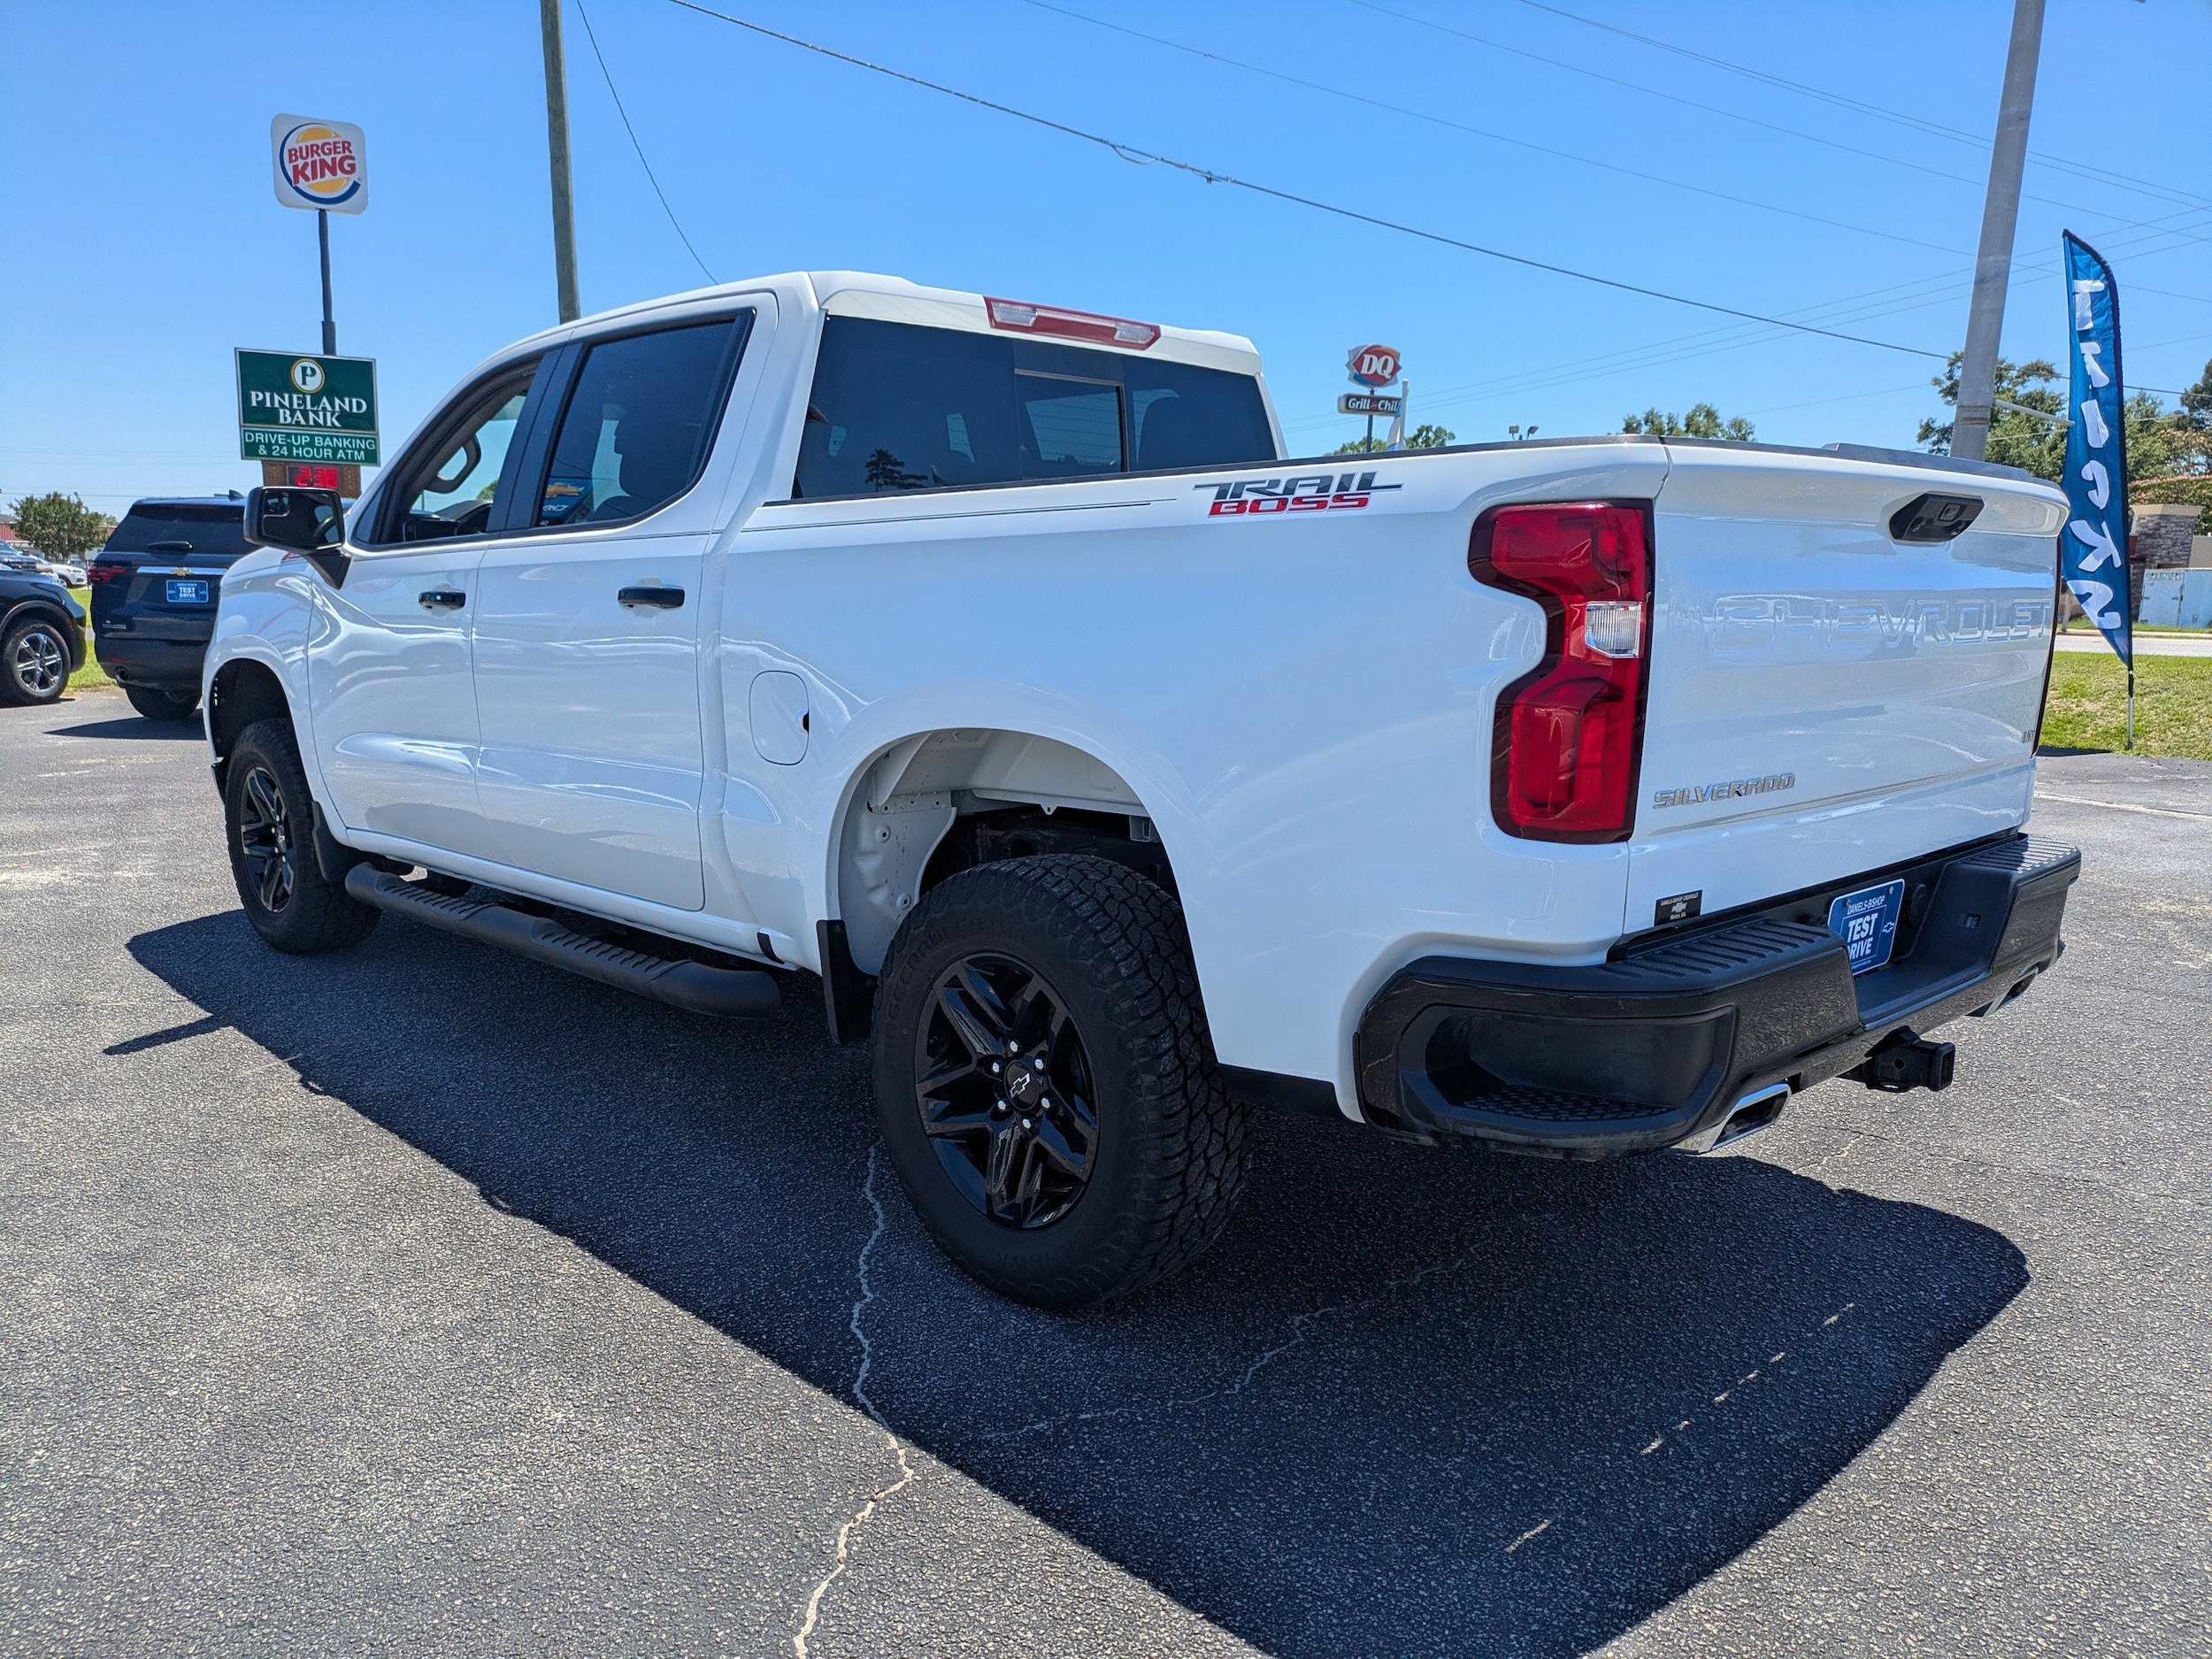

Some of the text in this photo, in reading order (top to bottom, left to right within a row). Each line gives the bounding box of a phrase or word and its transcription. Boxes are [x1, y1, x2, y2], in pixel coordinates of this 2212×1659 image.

[288, 140, 352, 165] BURGER
[291, 155, 357, 187] KING
[301, 365, 316, 386] P
[1360, 354, 1394, 379] DQ
[250, 390, 367, 414] PINELAND
[1348, 397, 1371, 411] Grill
[1378, 399, 1398, 412] Chil
[279, 408, 342, 427] BANK
[244, 432, 376, 450] DRIVE-UP BANKING
[257, 445, 365, 461] & 24 HOUR ATM
[1193, 470, 1405, 500] TRAIL
[1208, 492, 1371, 518] BOSS
[1653, 772, 1796, 810] SILVERADO
[1847, 895, 1886, 915] DANIELS-BISHOP
[1847, 912, 1878, 943] TEST
[1847, 937, 1873, 960] RIVE
